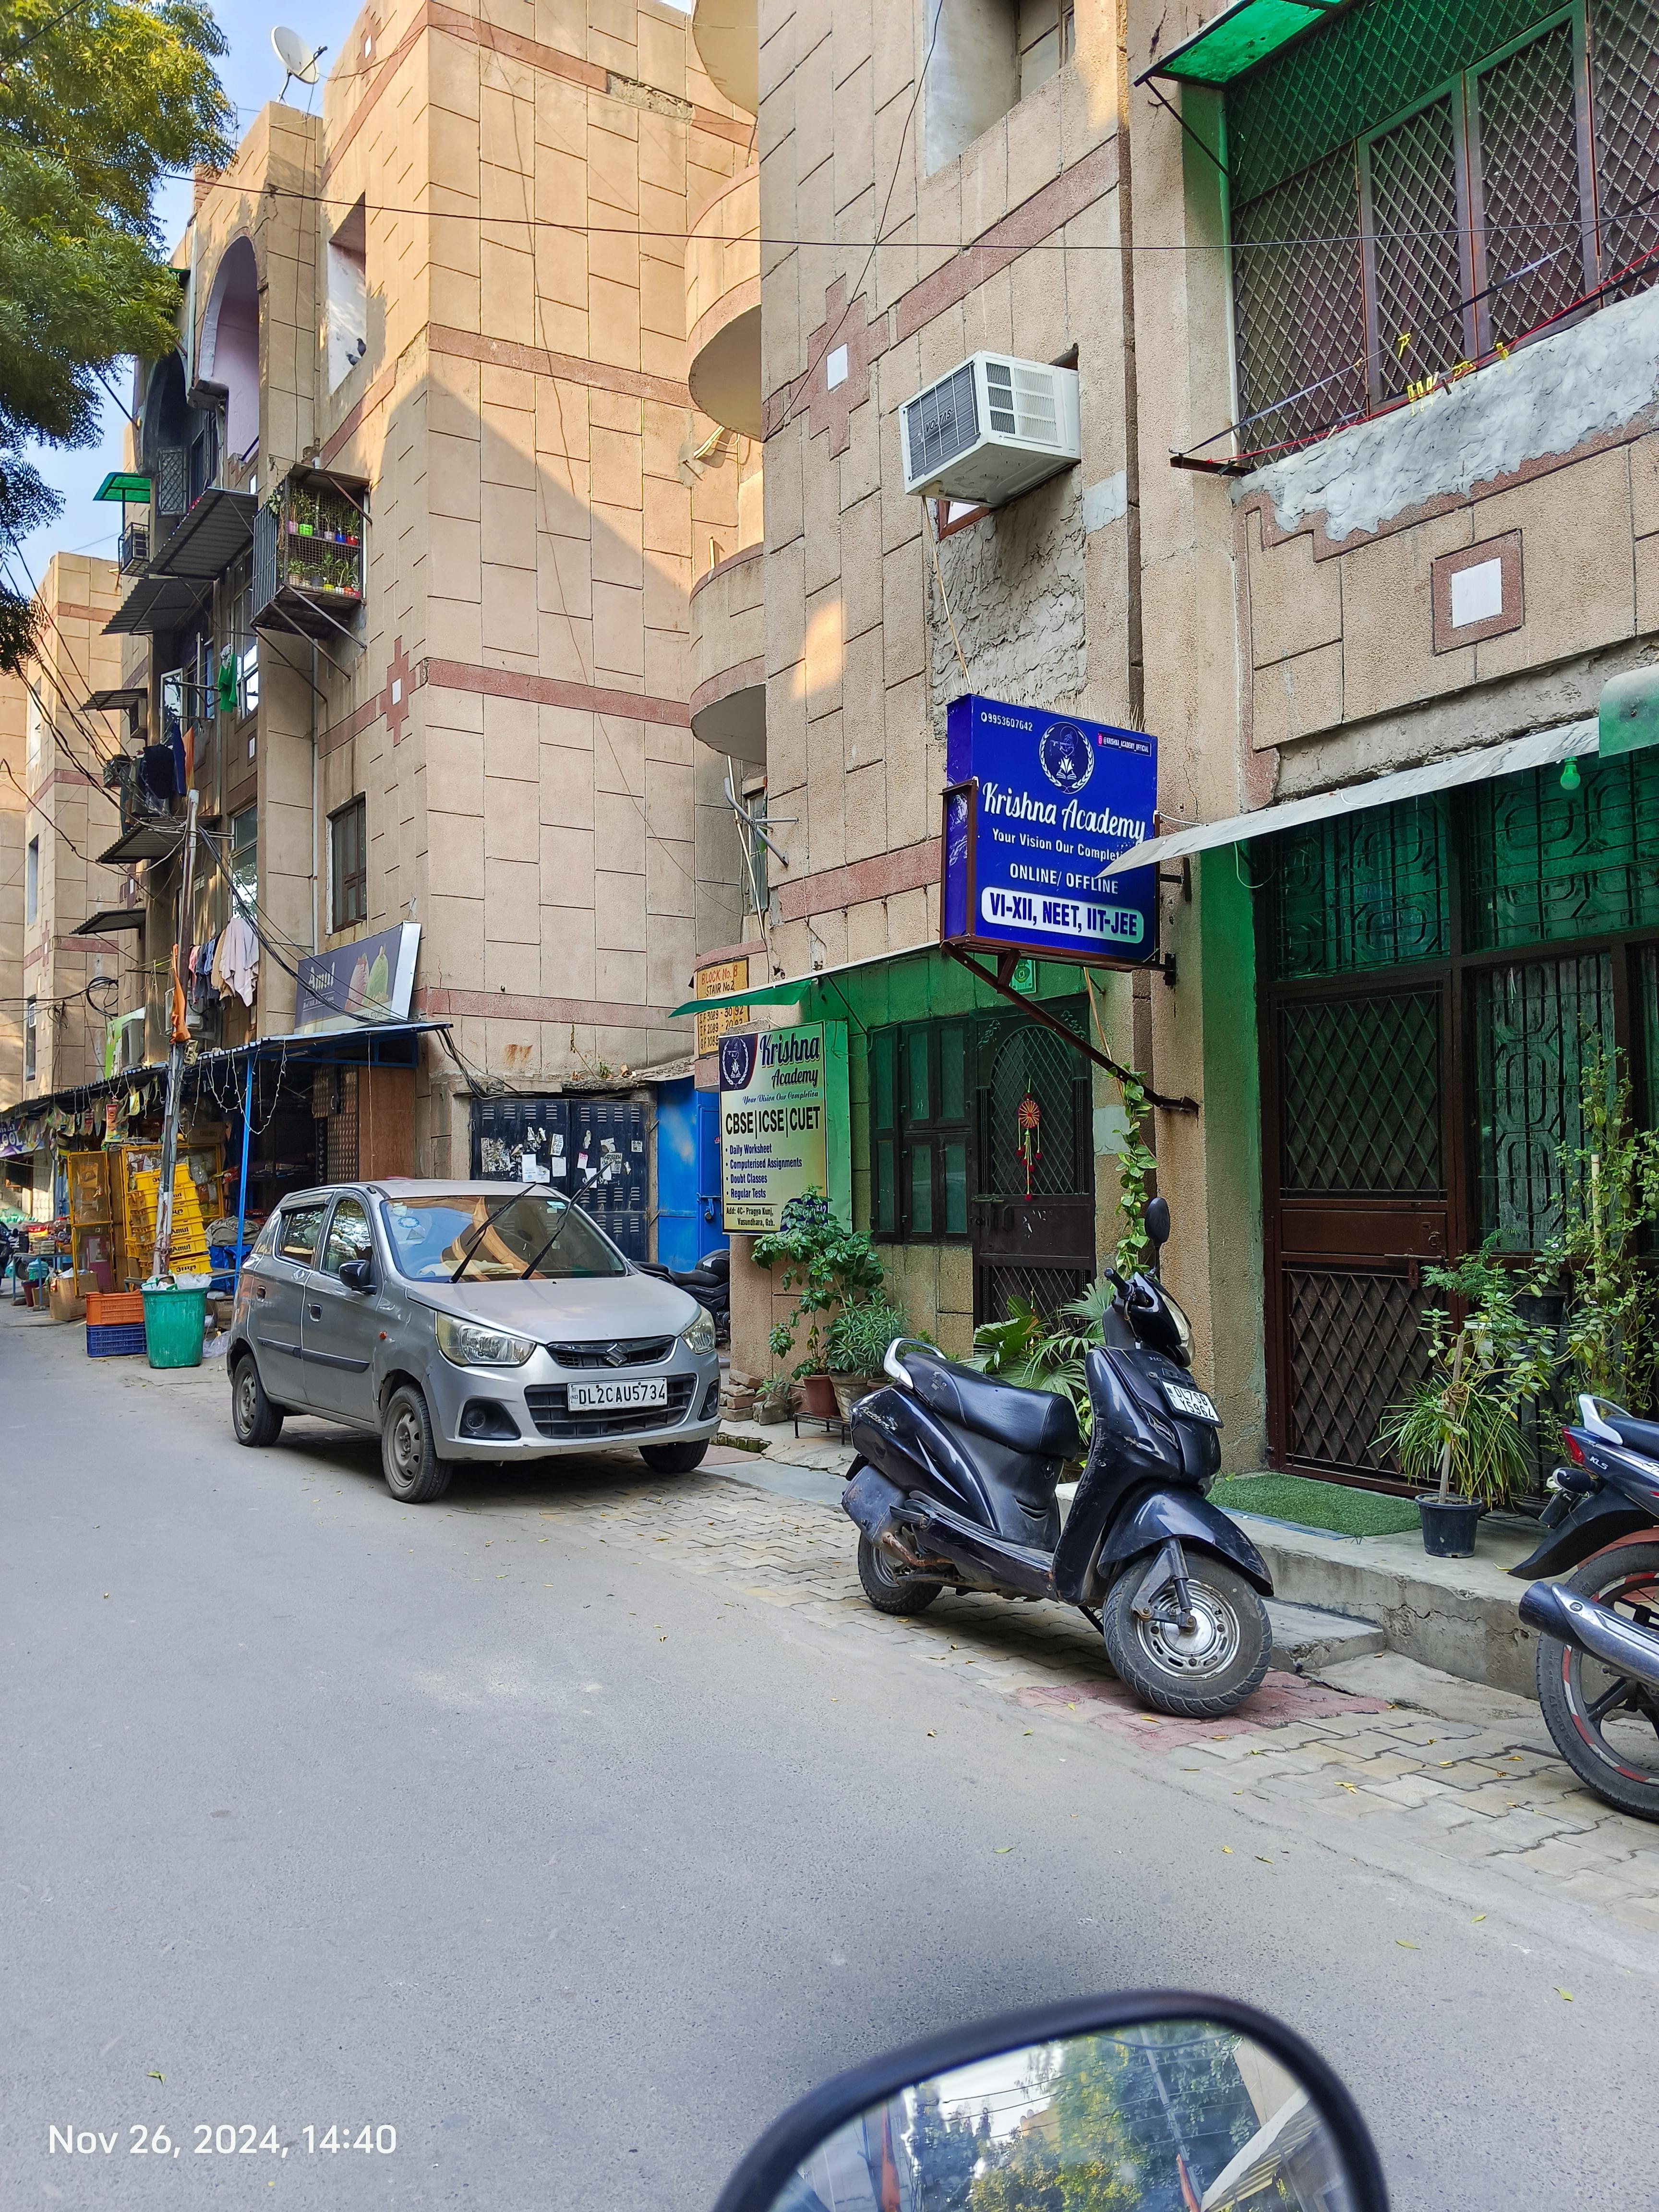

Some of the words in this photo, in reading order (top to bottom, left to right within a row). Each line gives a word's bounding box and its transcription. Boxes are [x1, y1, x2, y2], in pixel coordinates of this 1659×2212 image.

[926, 409, 951, 433] VOLTAS
[982, 782, 1057, 825] Krishna
[1062, 799, 1146, 846] Academy
[992, 828, 1015, 843] Your
[1020, 833, 1052, 851] Vision
[1056, 840, 1074, 854] Our
[1010, 863, 1062, 887] ONLINE/
[1066, 873, 1118, 894] OFFLINE
[990, 892, 1037, 926] VI-XII,
[1043, 901, 1082, 933] NEET,
[1087, 907, 1137, 936] IIT-JEE
[306, 962, 335, 994] Amul
[701, 969, 720, 985] BLOCK
[722, 968, 732, 980] No.
[706, 983, 721, 996] STAIR
[760, 1033, 820, 1067] Krishna
[771, 1068, 818, 1089] Academy
[743, 1095, 757, 1105] Your
[757, 1094, 775, 1103] Vision
[788, 1090, 818, 1100] Completion
[730, 1144, 742, 1156] Daily
[744, 1143, 772, 1154] Worksheet
[730, 1159, 766, 1171] Computerised
[768, 1157, 802, 1170] Assignments
[731, 1174, 745, 1184] Doubt
[747, 1173, 768, 1183] Classes
[731, 1188, 751, 1200] Regular
[752, 1188, 766, 1198] Tests
[746, 1208, 761, 1216] Pragya
[762, 1207, 774, 1216] Kunj,
[171, 1226, 189, 1235] Amul
[737, 1218, 764, 1227] Vasundhara,
[172, 1244, 191, 1252] Amul
[578, 1383, 665, 1405] DL2CAU5734
[1173, 1386, 1208, 1406] DL7SB
[1589, 1456, 1609, 1470] KLS
